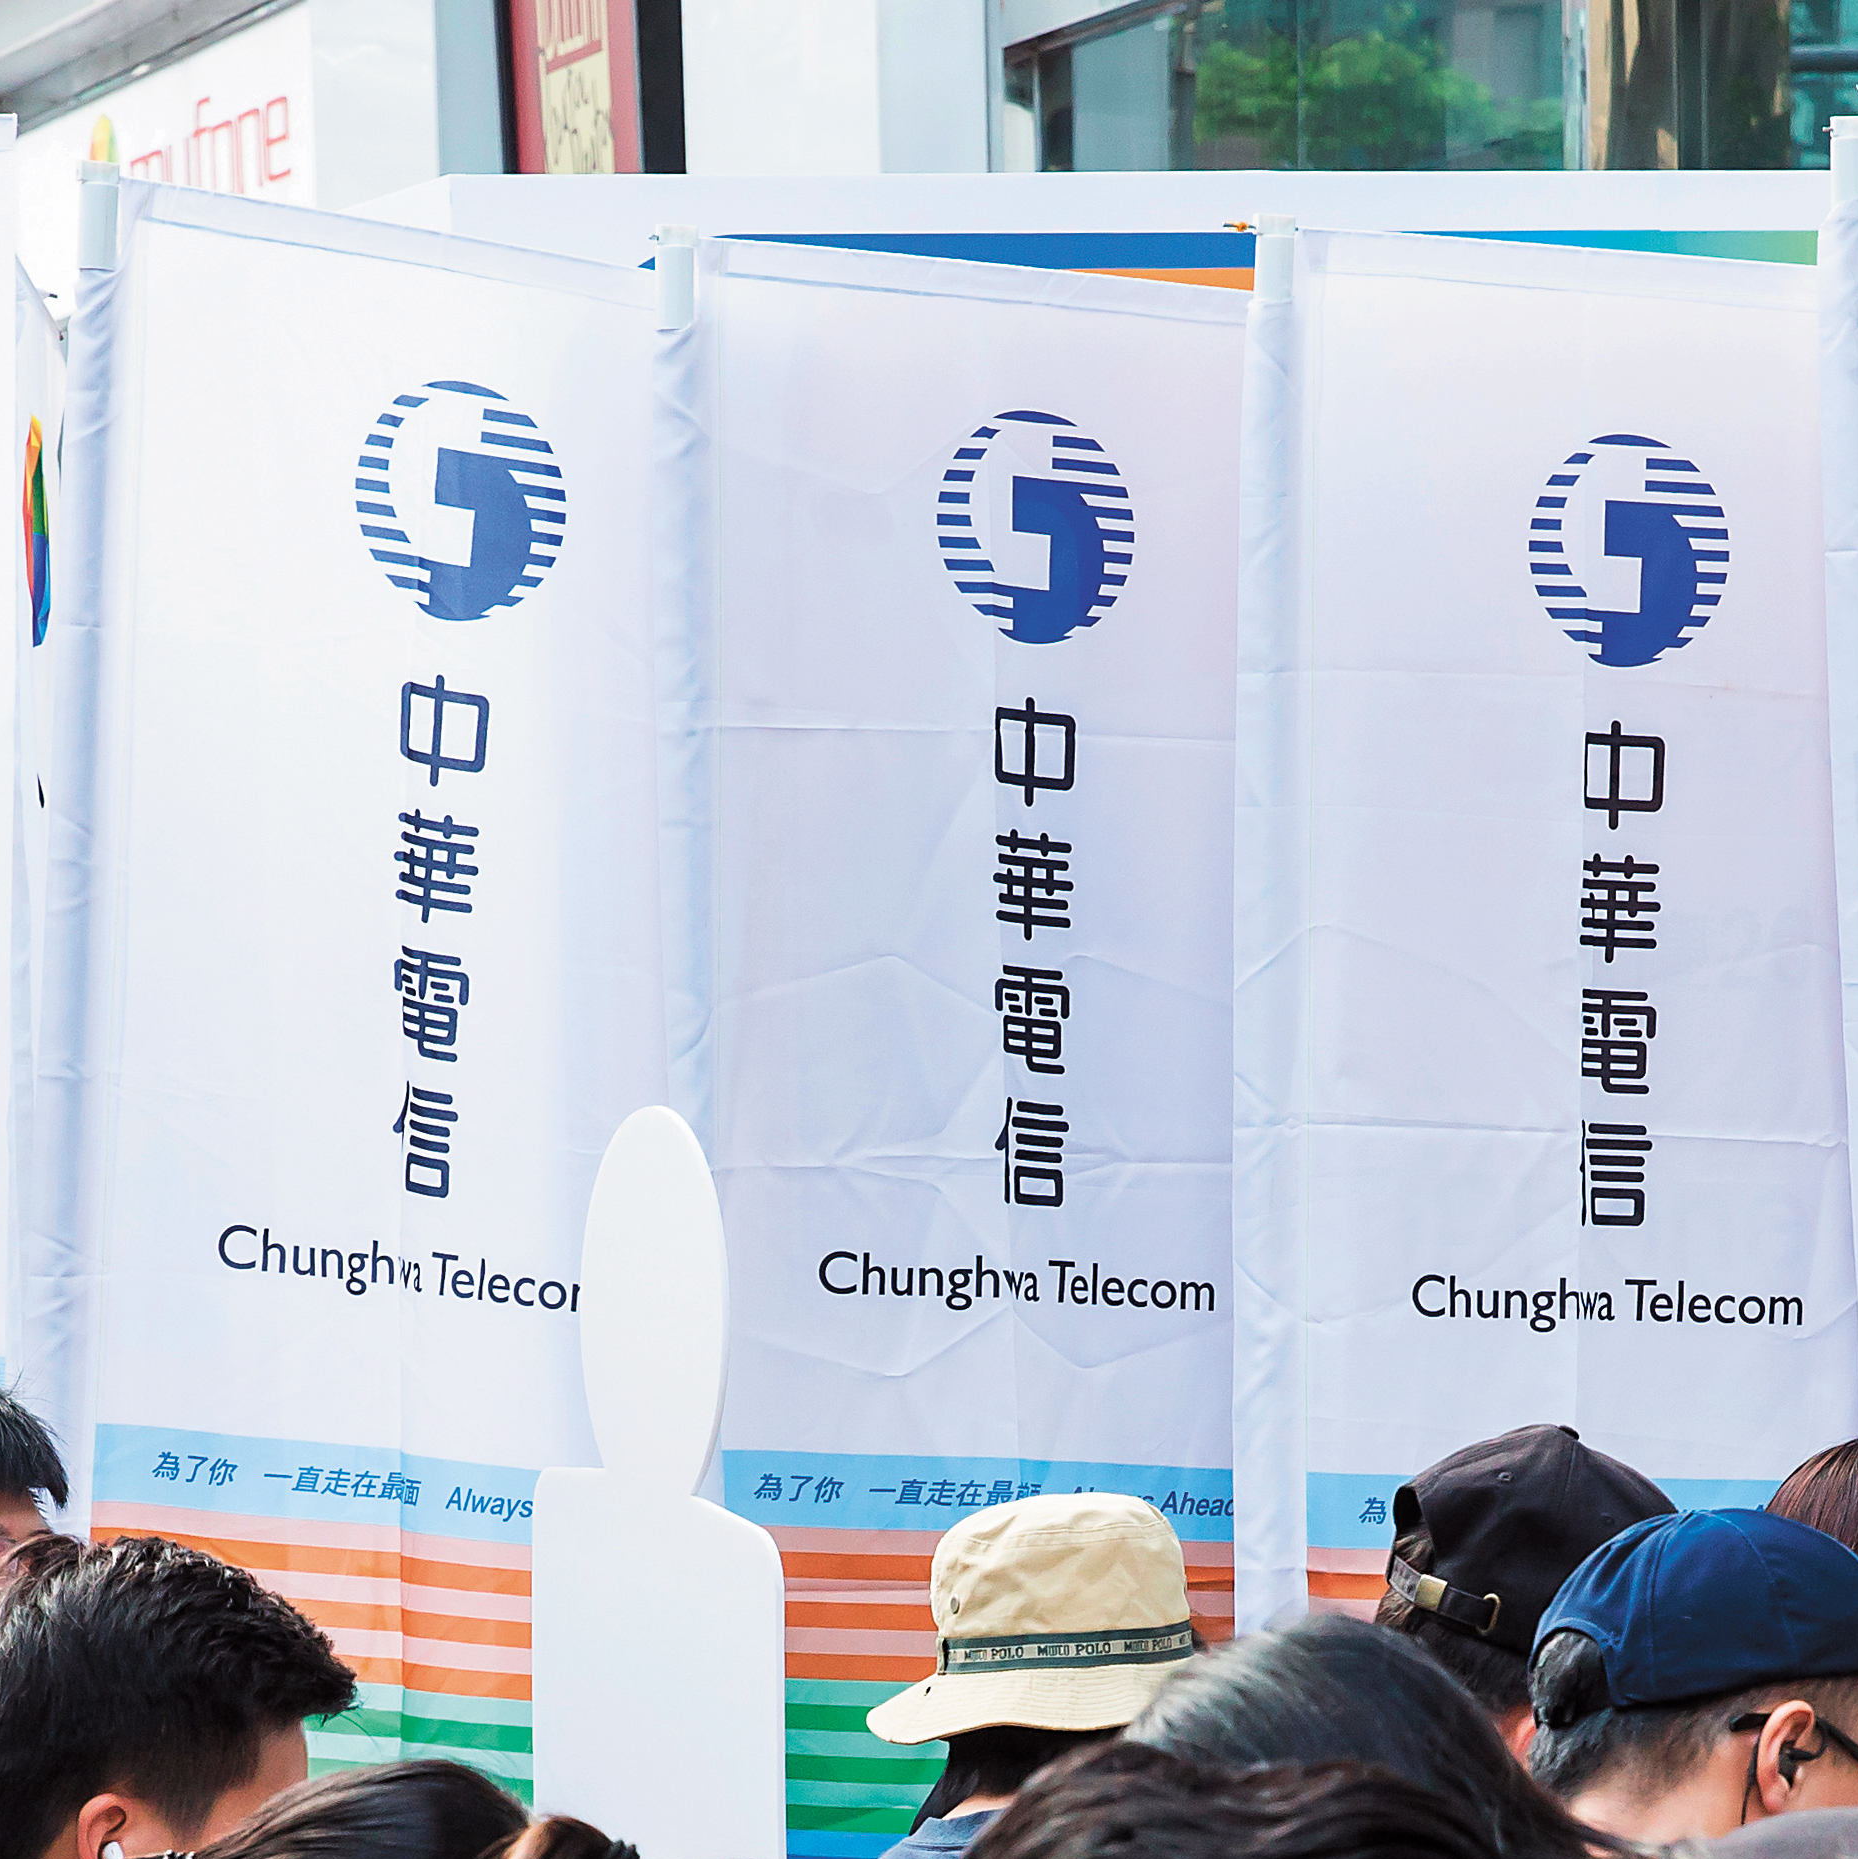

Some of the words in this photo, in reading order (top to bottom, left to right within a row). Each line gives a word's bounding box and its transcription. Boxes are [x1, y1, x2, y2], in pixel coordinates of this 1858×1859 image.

[391, 673, 491, 1200] 中華電信
[991, 695, 1078, 1209] 中華電信
[1578, 719, 1667, 1228] 中華電信
[217, 1223, 424, 1297] Chunghwa
[817, 1249, 1041, 1312] Chunghwa
[1047, 1258, 1216, 1313] Telecom
[1411, 1273, 1617, 1334] Chunghwa
[1623, 1277, 1804, 1327] Telecom
[151, 1451, 239, 1487] 為了你
[444, 1486, 533, 1523] Always
[753, 1473, 845, 1504] 為了你
[1074, 1641, 1111, 1655] POLO
